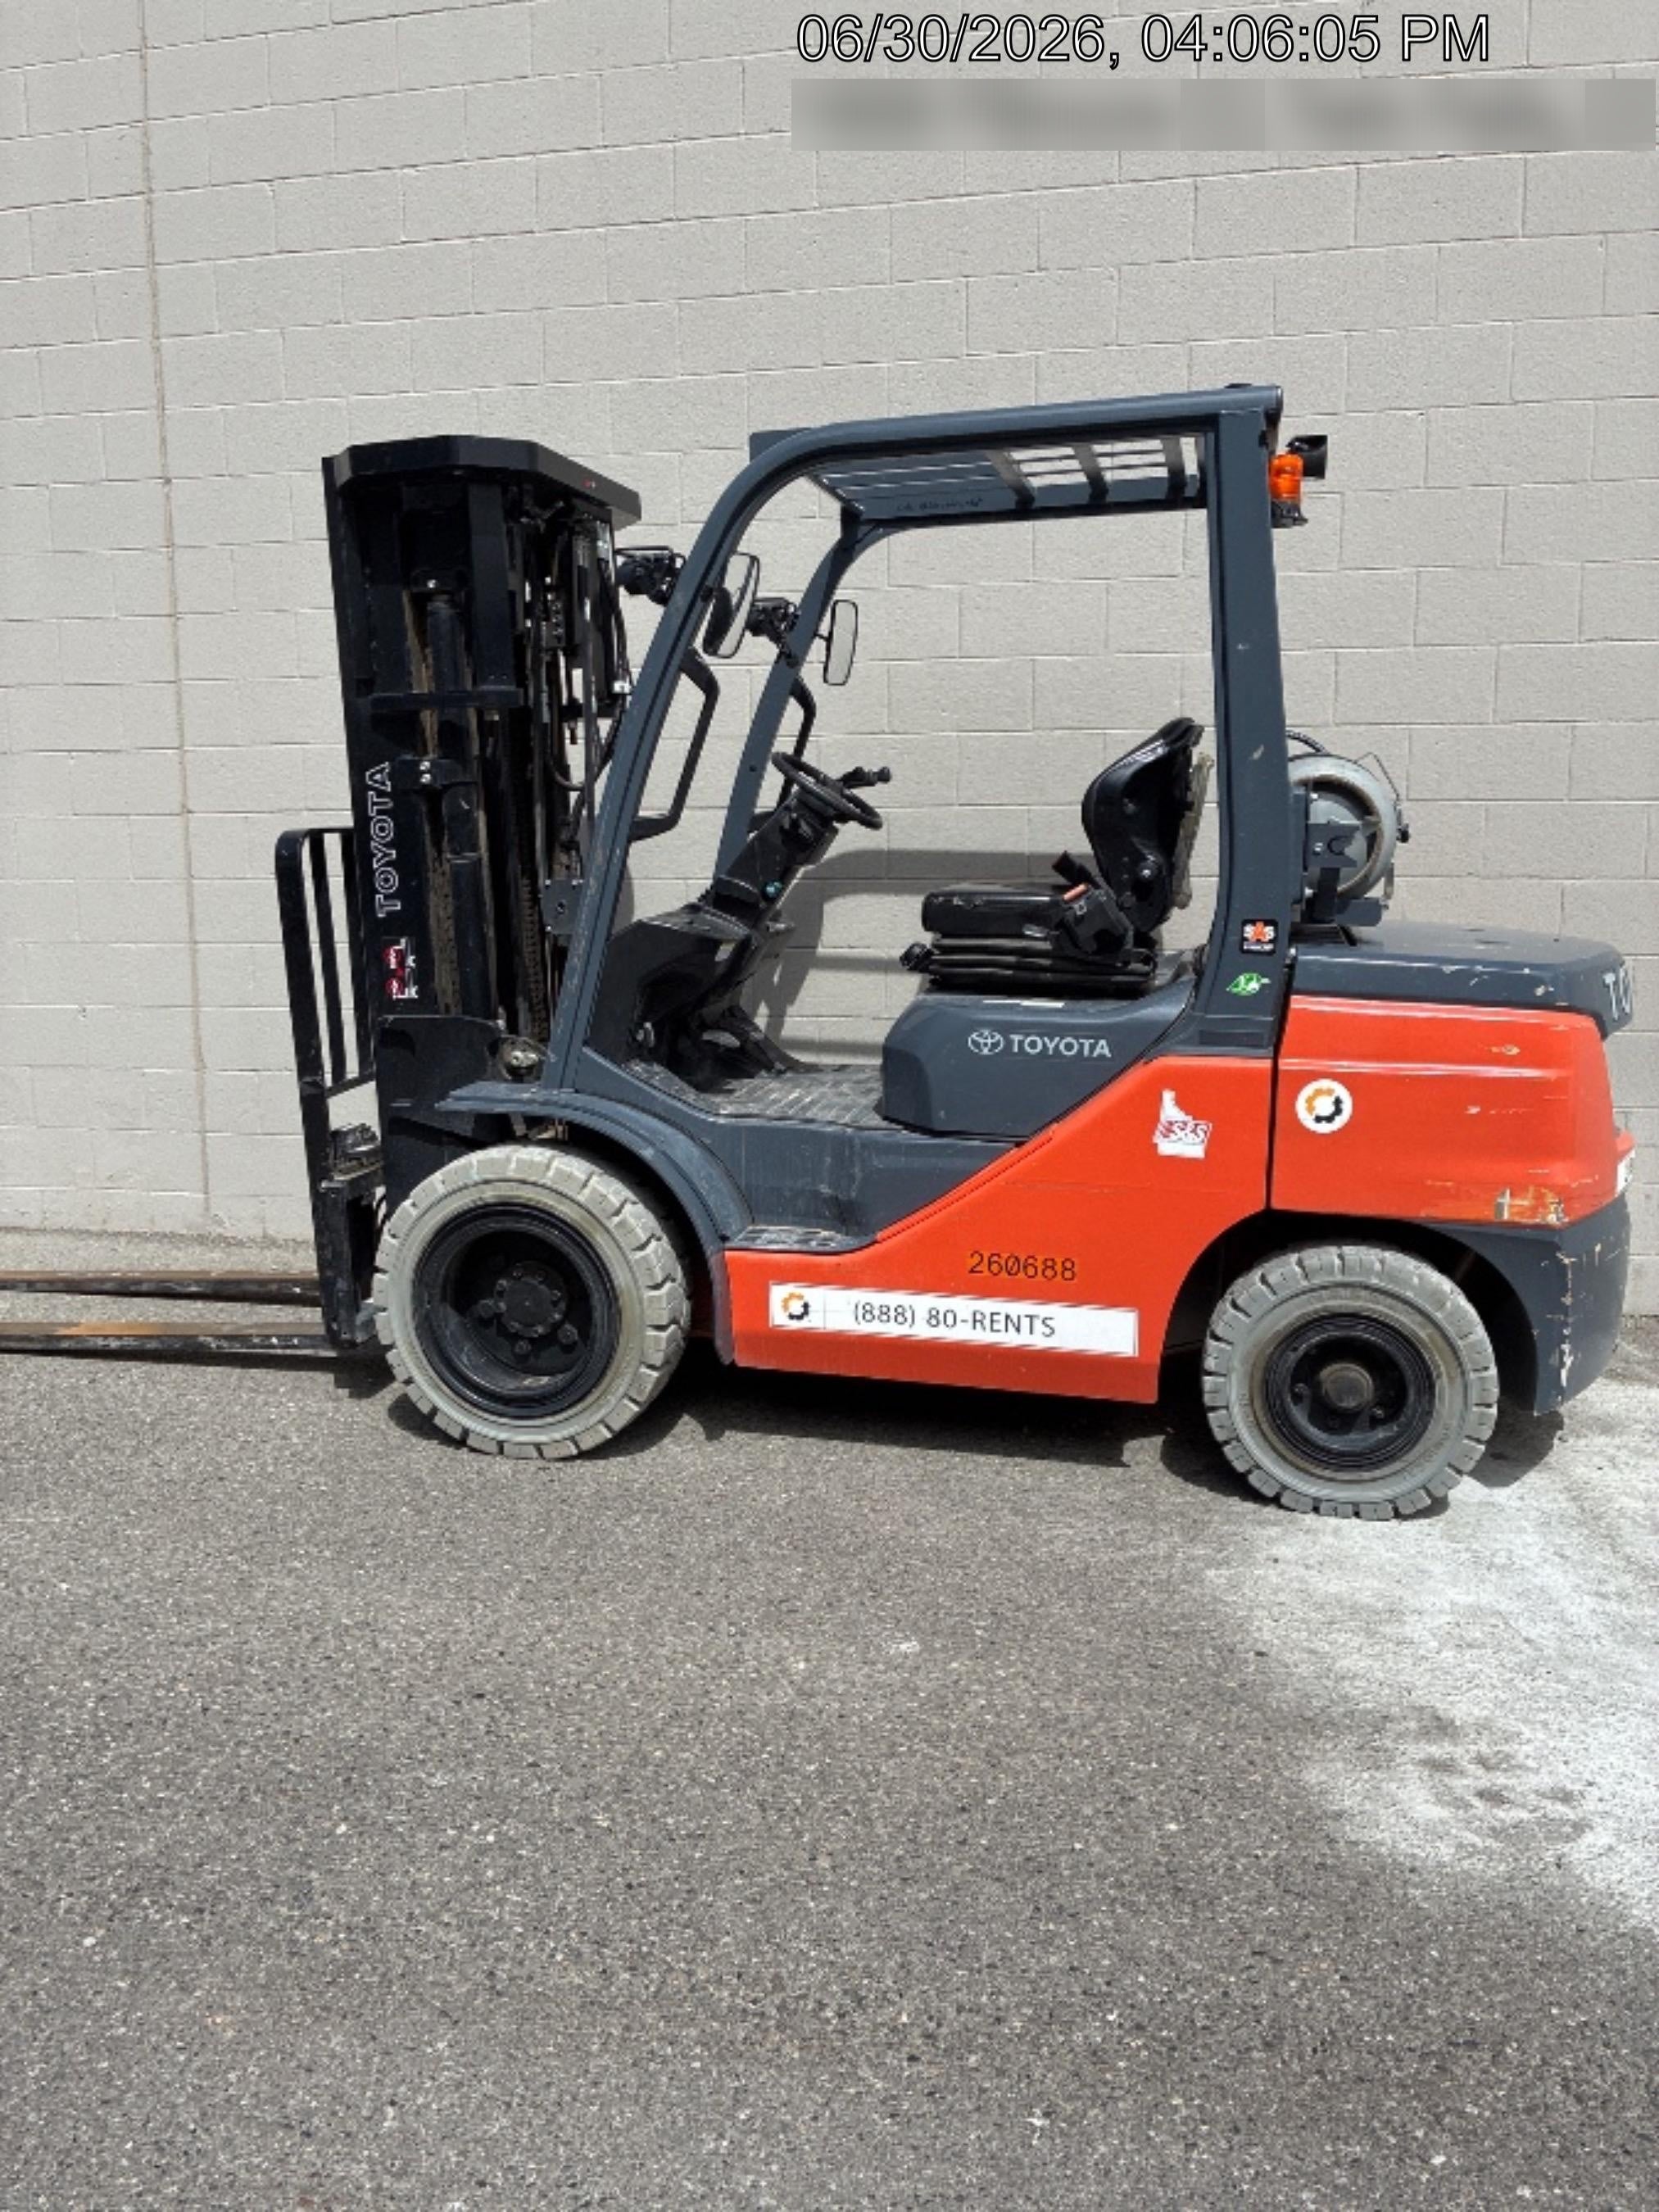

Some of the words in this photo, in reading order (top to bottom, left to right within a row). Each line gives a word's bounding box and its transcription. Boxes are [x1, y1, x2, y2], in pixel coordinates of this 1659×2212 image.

[365, 761, 402, 918] TOYOTA
[1009, 1034, 1113, 1058] TOYOTA
[968, 1250, 1077, 1281] 260688
[854, 1301, 916, 1329] (888)
[926, 1306, 1055, 1338] 80-RENTS
